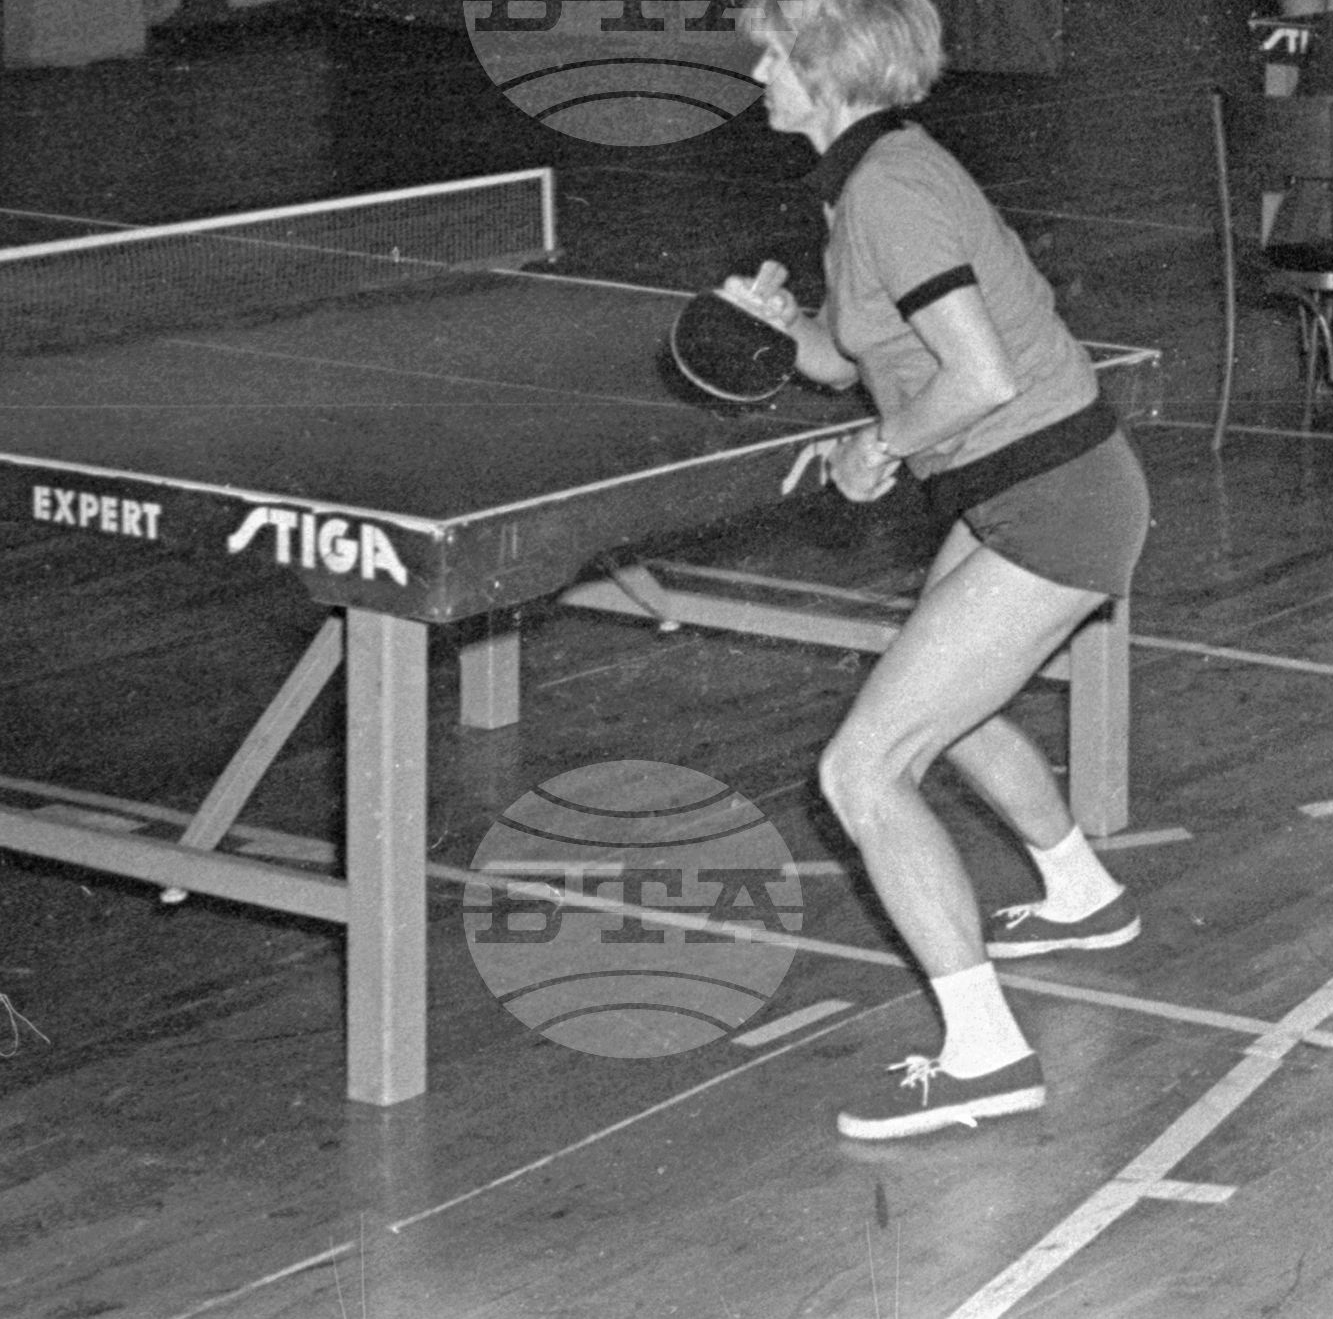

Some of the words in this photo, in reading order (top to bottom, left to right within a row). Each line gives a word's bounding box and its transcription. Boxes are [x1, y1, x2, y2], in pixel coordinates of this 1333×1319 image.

[1261, 28, 1309, 54] STI
[33, 485, 162, 540] EXPERT
[227, 506, 408, 586] STIGA
